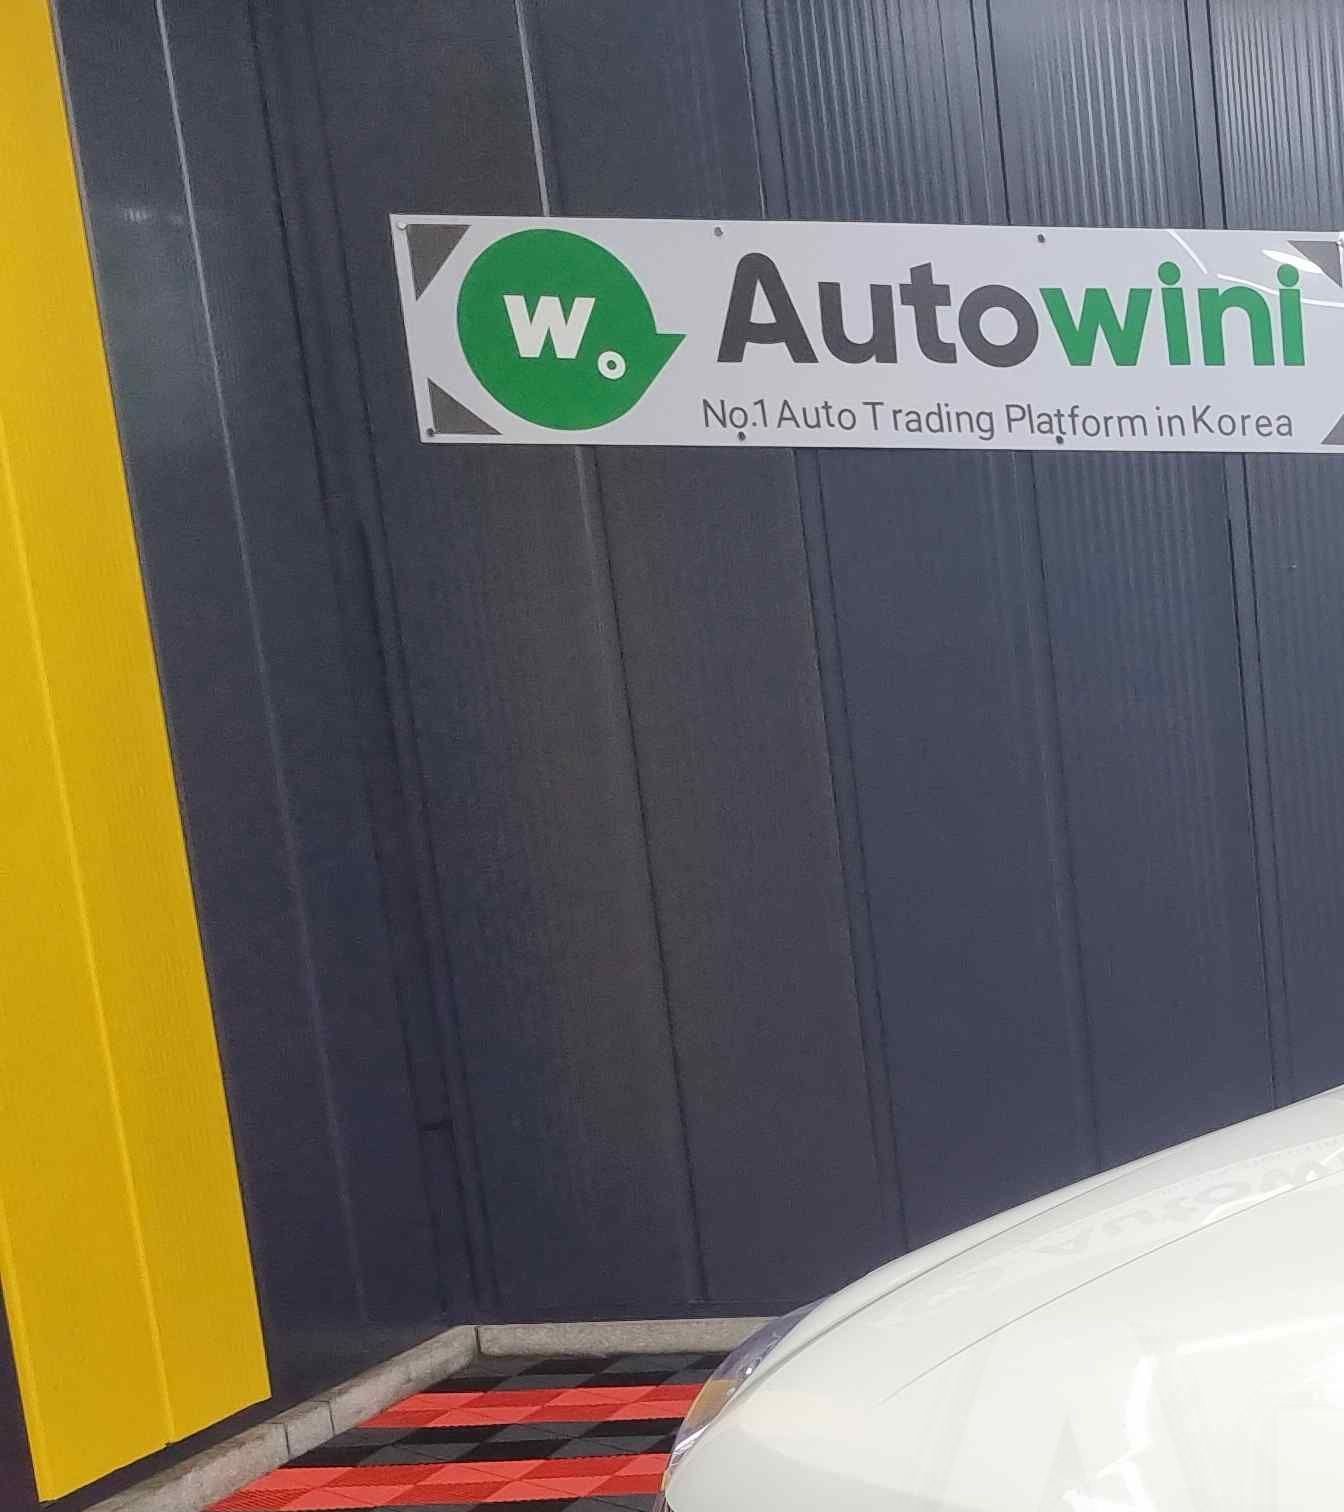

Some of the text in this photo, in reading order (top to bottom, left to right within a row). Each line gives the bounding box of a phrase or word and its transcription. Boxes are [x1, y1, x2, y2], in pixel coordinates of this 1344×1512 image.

[717, 251, 1302, 367] Autowini
[702, 398, 769, 430] No.1
[777, 398, 857, 431] Auto
[1005, 403, 1149, 438] Platform
[1155, 405, 1186, 437] in
[1191, 404, 1294, 437] Korea
